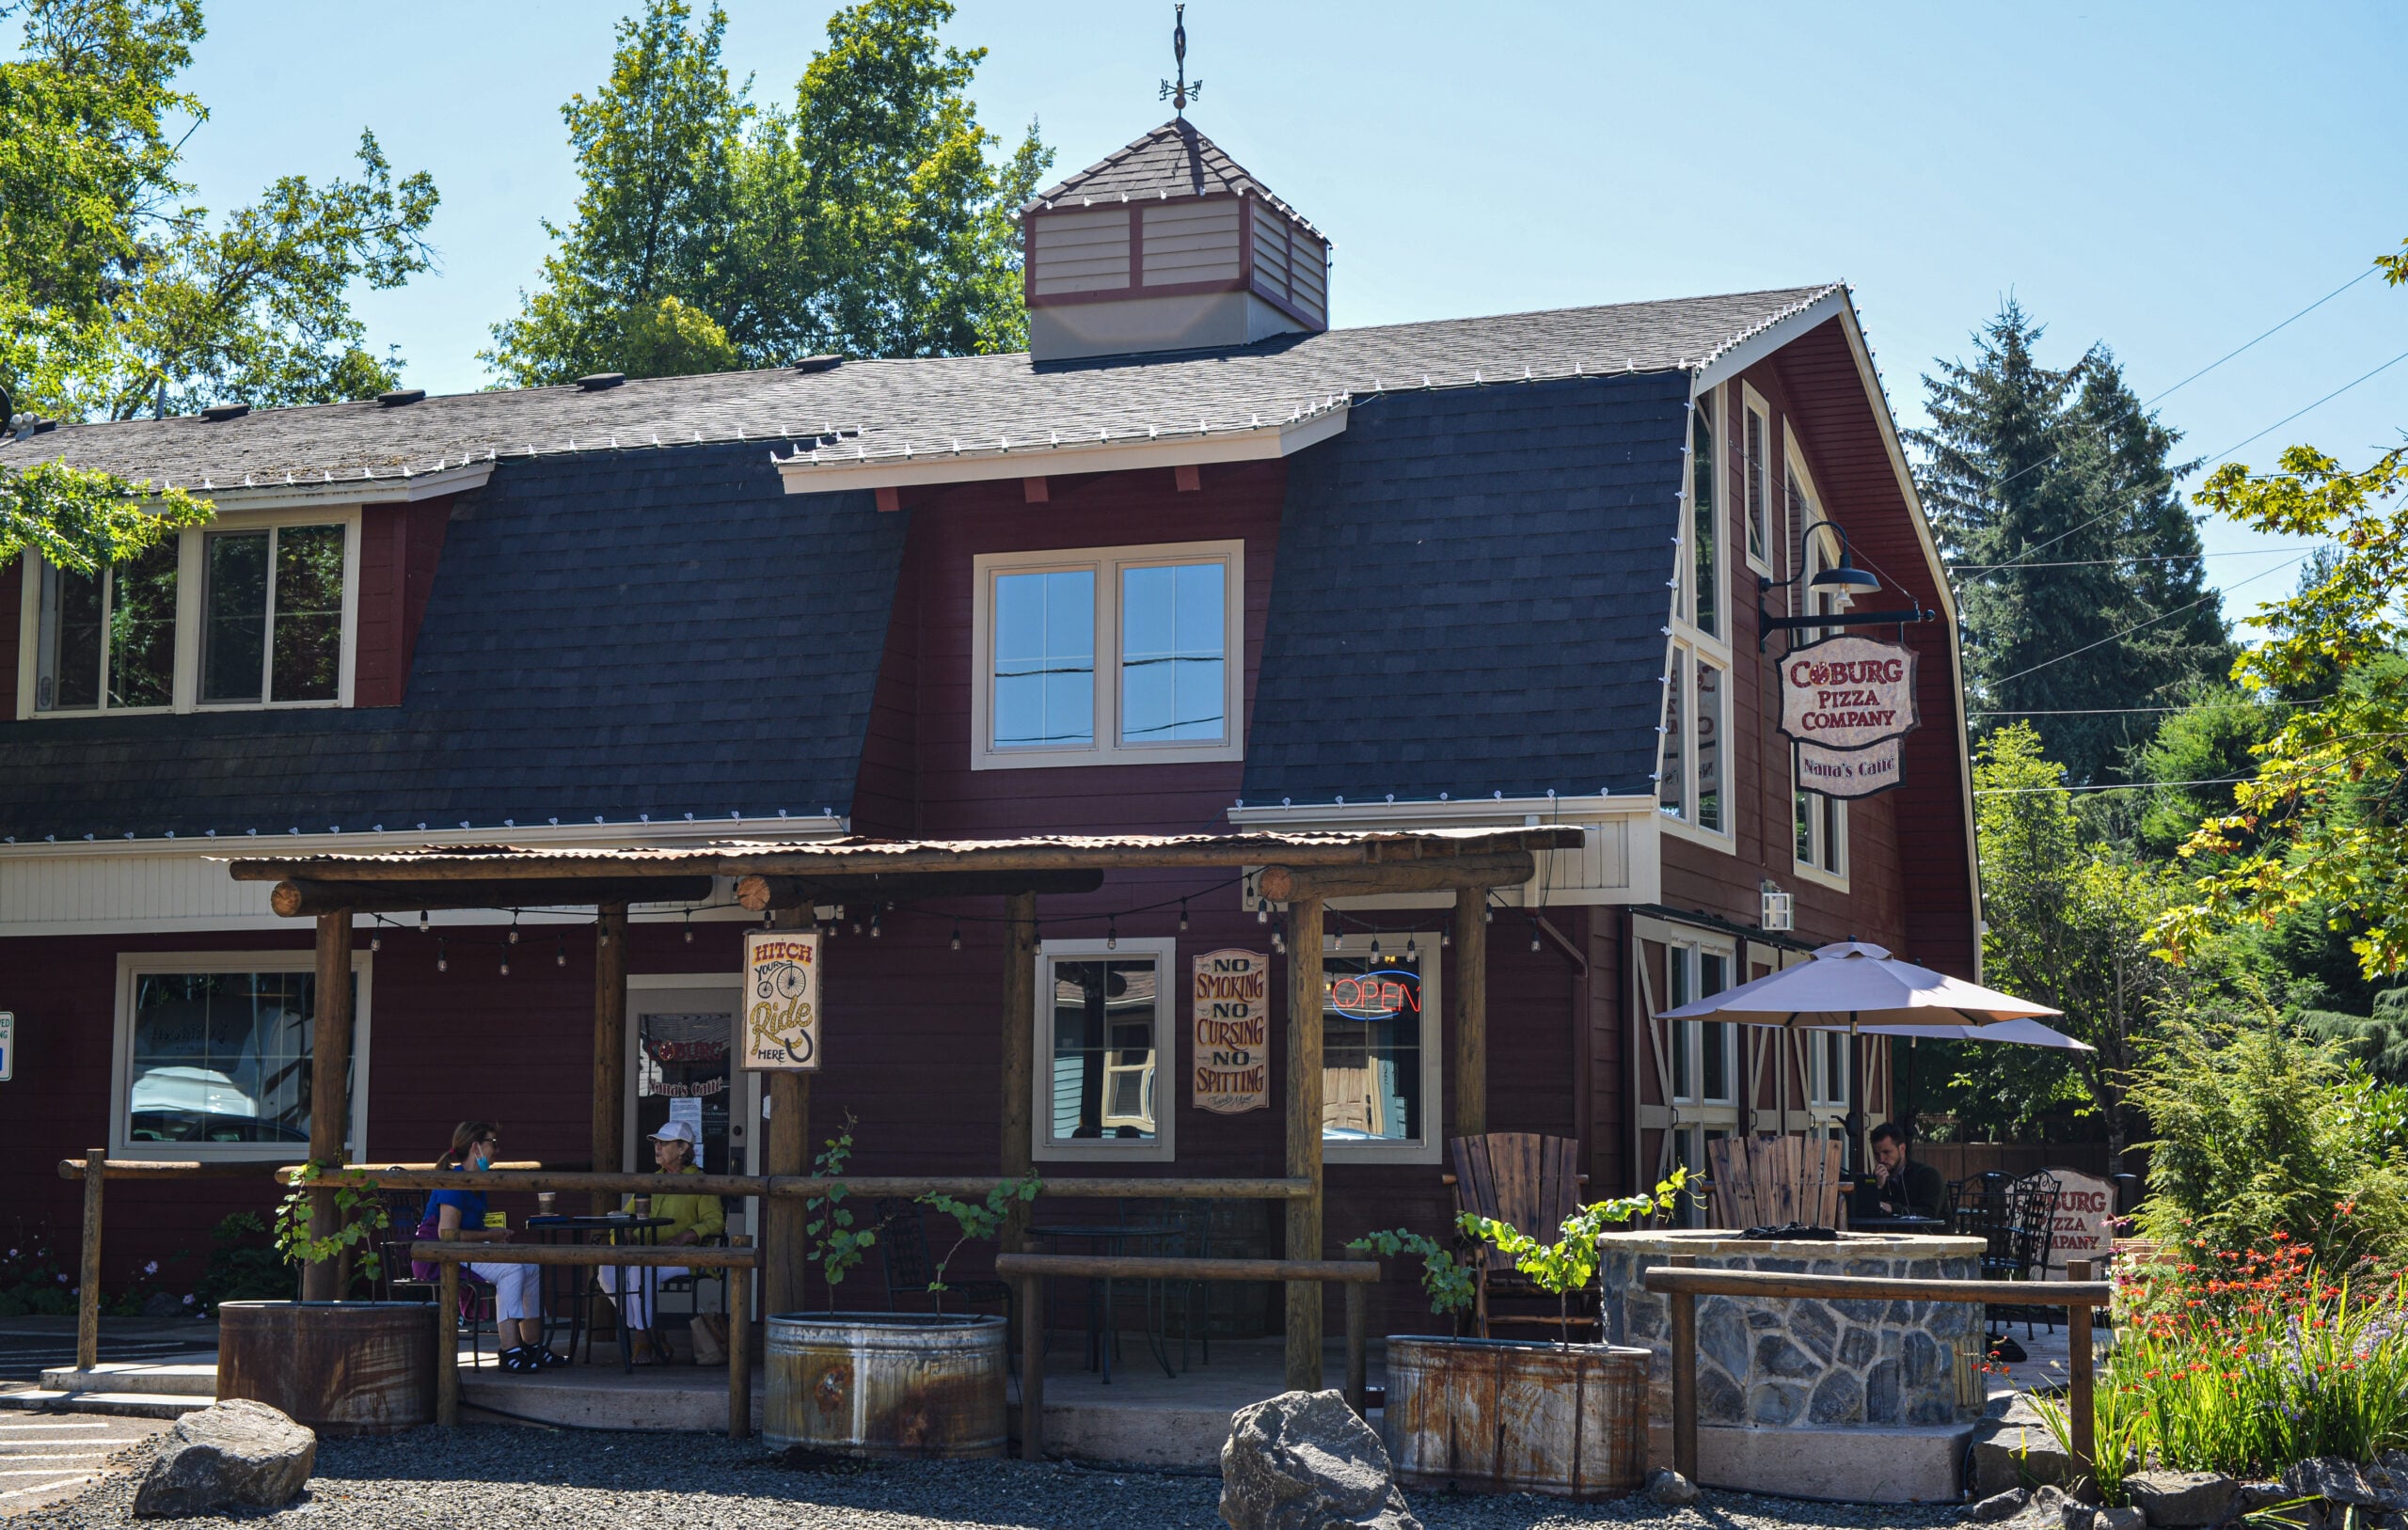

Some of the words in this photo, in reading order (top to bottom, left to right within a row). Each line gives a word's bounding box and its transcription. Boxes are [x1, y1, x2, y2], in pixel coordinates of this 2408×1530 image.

[1790, 658, 1904, 688] COBURG
[1817, 689, 1880, 709] PIZZA
[1801, 710, 1896, 731] COMPANY
[1804, 758, 1853, 777] Nana's
[754, 941, 813, 964] HITCH
[1213, 958, 1250, 972] NO
[1196, 970, 1264, 1002] SMOKING
[1333, 978, 1420, 1013] OPEN
[1212, 1003, 1249, 1017] NO
[750, 994, 813, 1055] Ride
[1196, 1016, 1265, 1051] CURSING
[758, 1049, 785, 1063] HERE
[1212, 1051, 1250, 1065] NO
[1196, 1065, 1264, 1093] SPITTING
[2024, 1191, 2106, 1214] BURG
